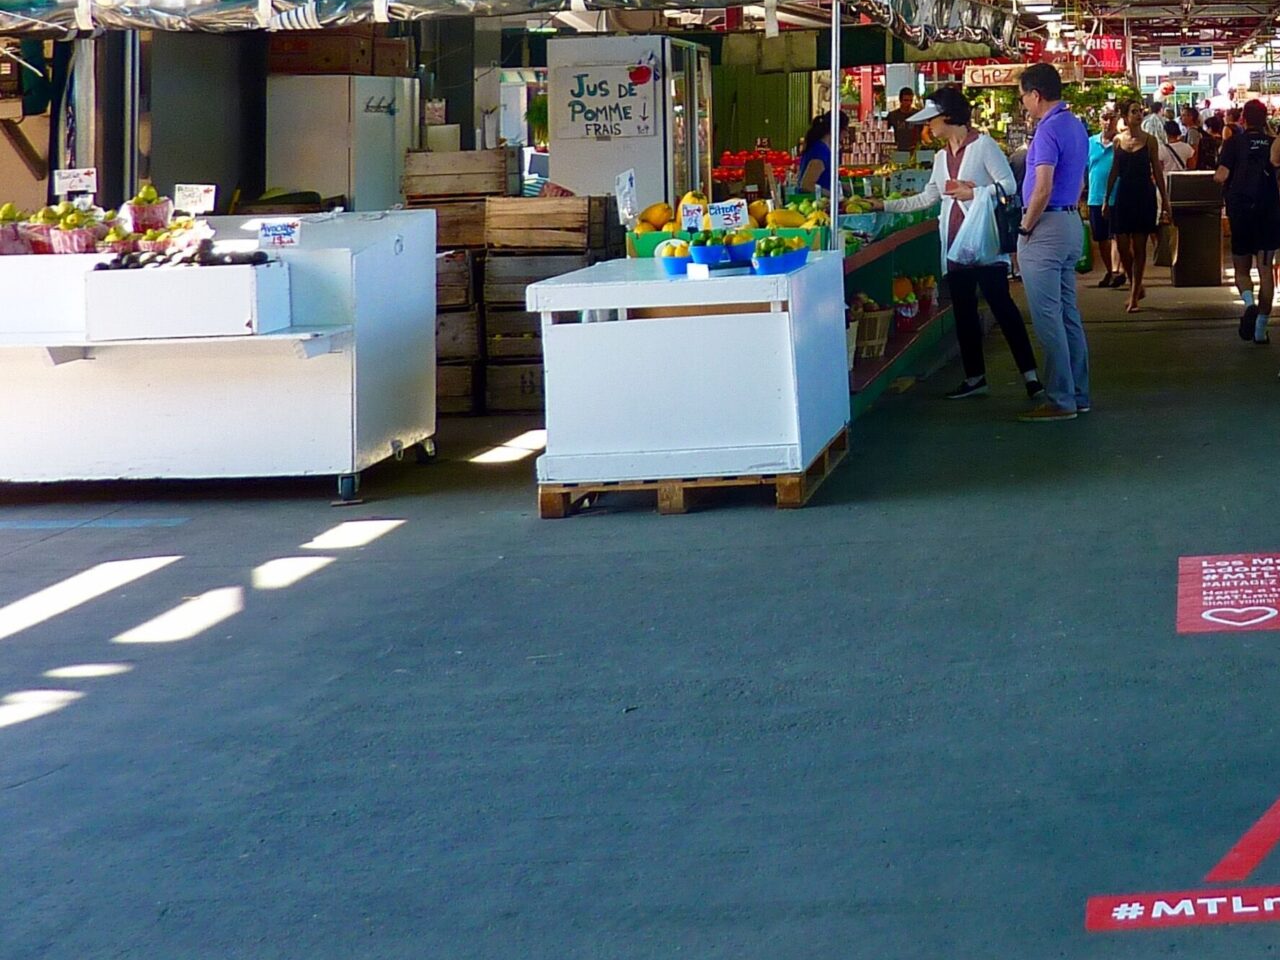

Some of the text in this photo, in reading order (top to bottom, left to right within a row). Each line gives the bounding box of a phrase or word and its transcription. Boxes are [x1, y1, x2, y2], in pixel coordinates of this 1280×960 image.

[618, 83, 638, 98] DE
[568, 100, 632, 122] POMME
[585, 123, 622, 136] FRAIS
[1201, 560, 1244, 568] Les
[1202, 578, 1277, 588] PARTAGEZ
